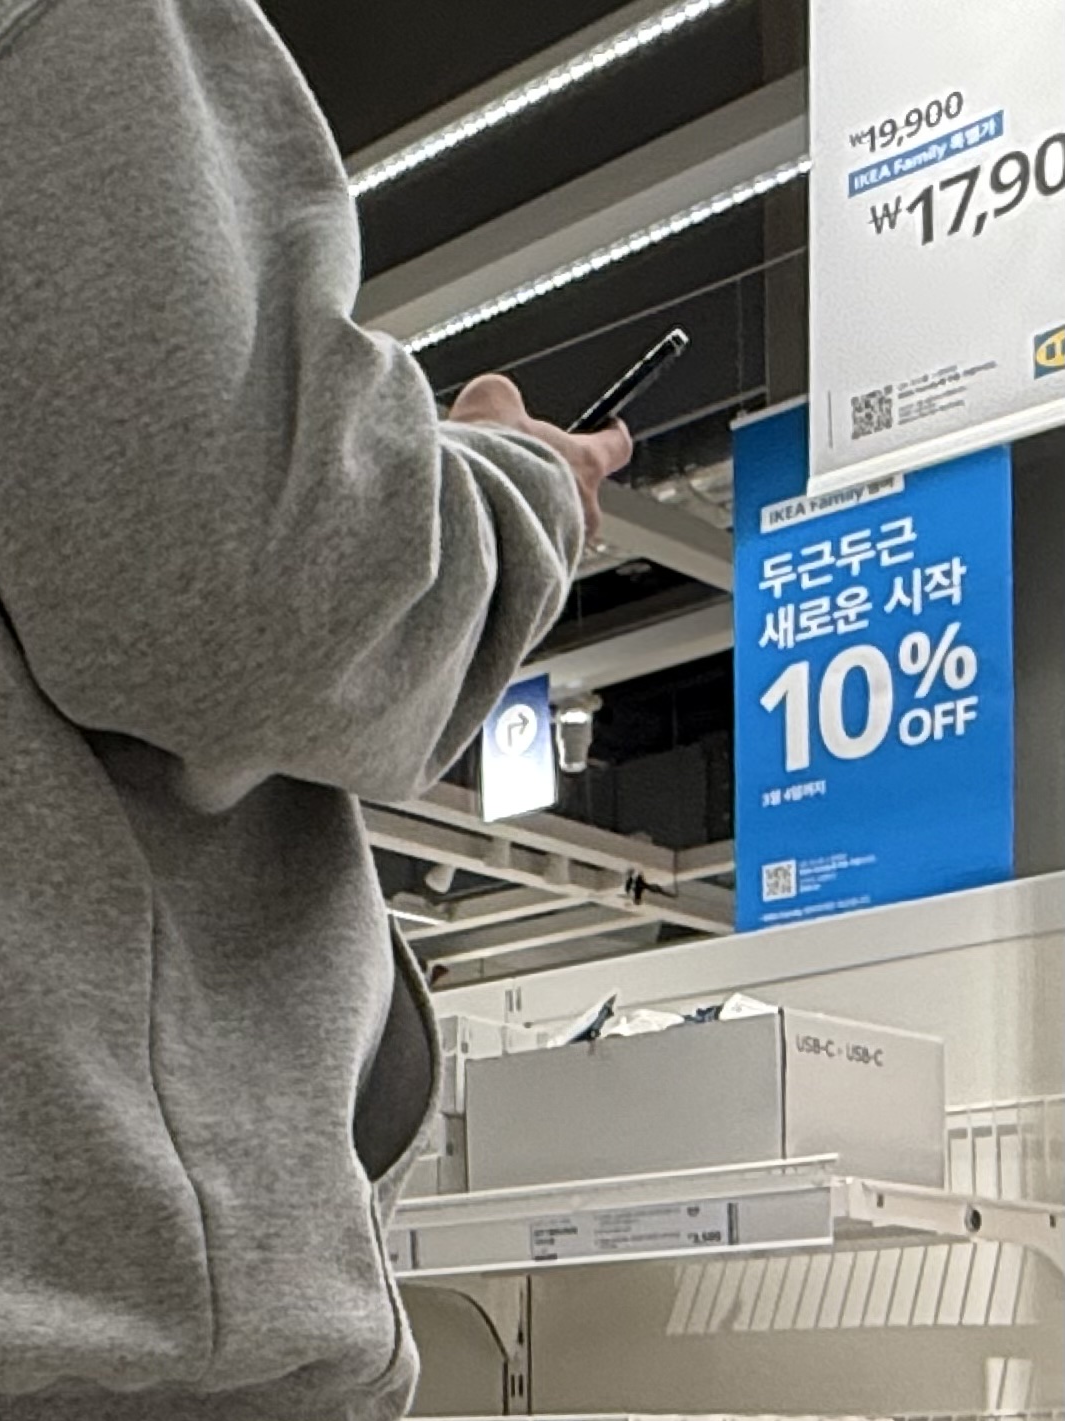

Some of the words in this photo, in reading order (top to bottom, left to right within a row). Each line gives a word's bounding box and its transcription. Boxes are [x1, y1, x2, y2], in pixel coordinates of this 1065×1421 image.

[853, 164, 891, 190] IKEA
[893, 141, 947, 175] Family
[769, 502, 806, 525] IKEA
[759, 517, 917, 599] 두근두근
[759, 586, 872, 650] 새로운
[884, 556, 967, 616] 시작
[899, 695, 978, 746] OFF
[796, 1035, 835, 1058] USB-C
[845, 1042, 883, 1067] USB-C
